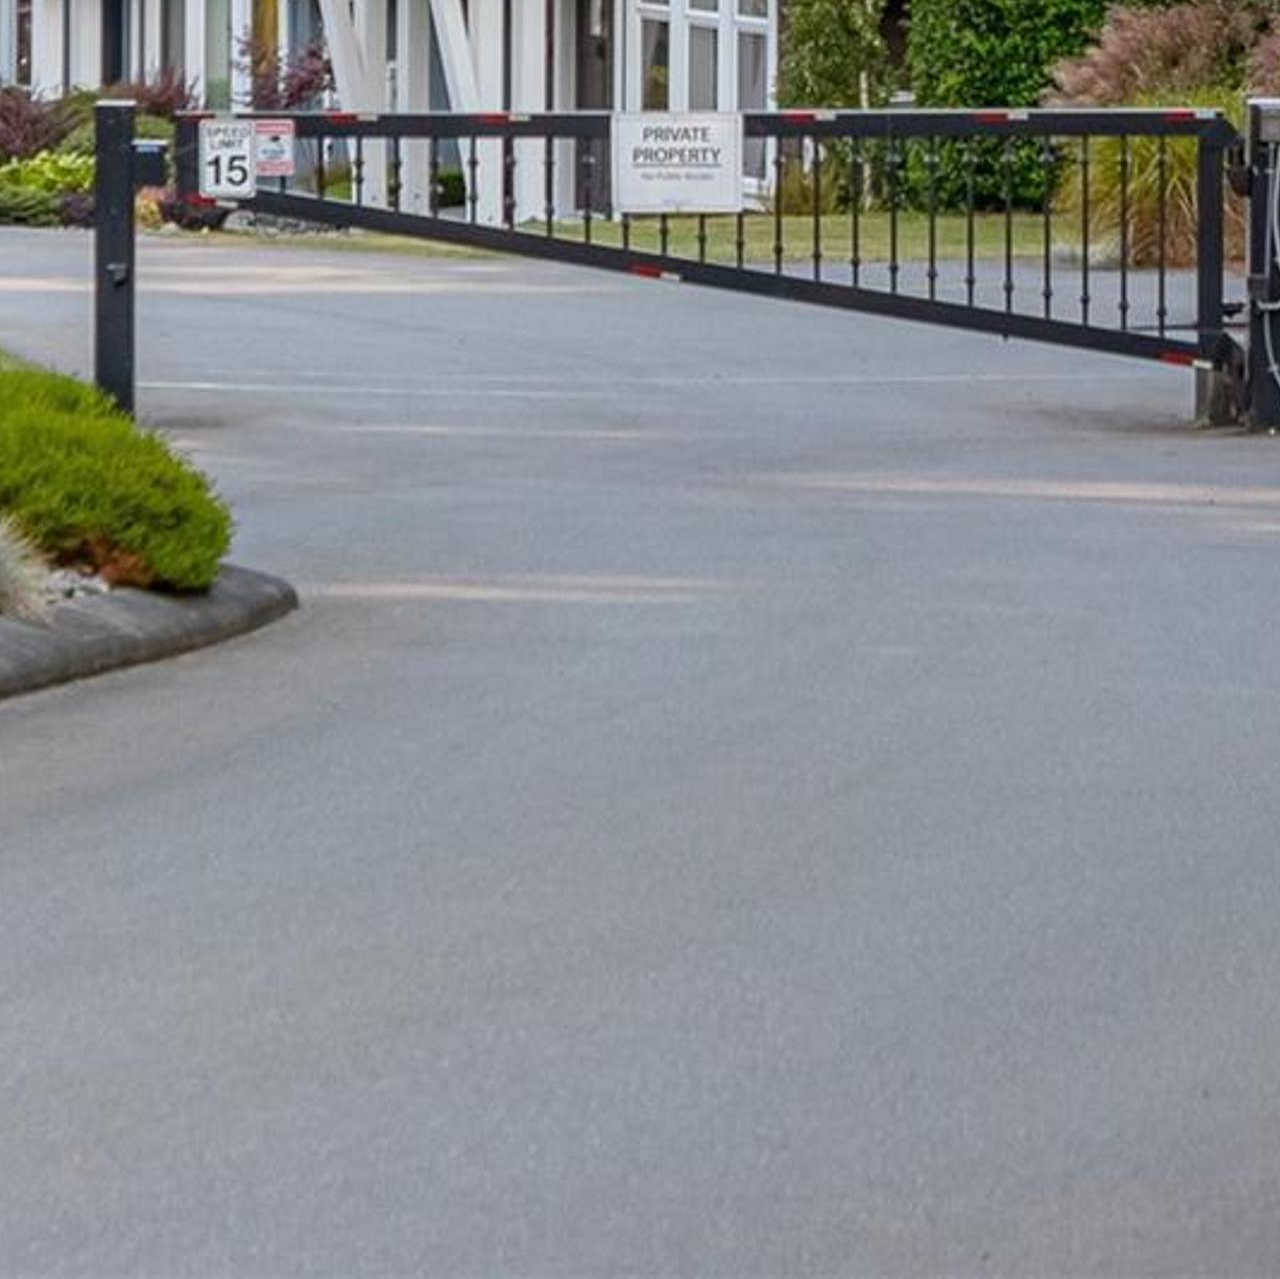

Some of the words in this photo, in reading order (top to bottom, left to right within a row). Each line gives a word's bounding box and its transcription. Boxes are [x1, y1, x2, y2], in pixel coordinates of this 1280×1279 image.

[205, 126, 251, 138] SPEED
[642, 126, 711, 142] PRIVATE
[632, 147, 721, 162] PROPERTY
[207, 154, 248, 186] 15
